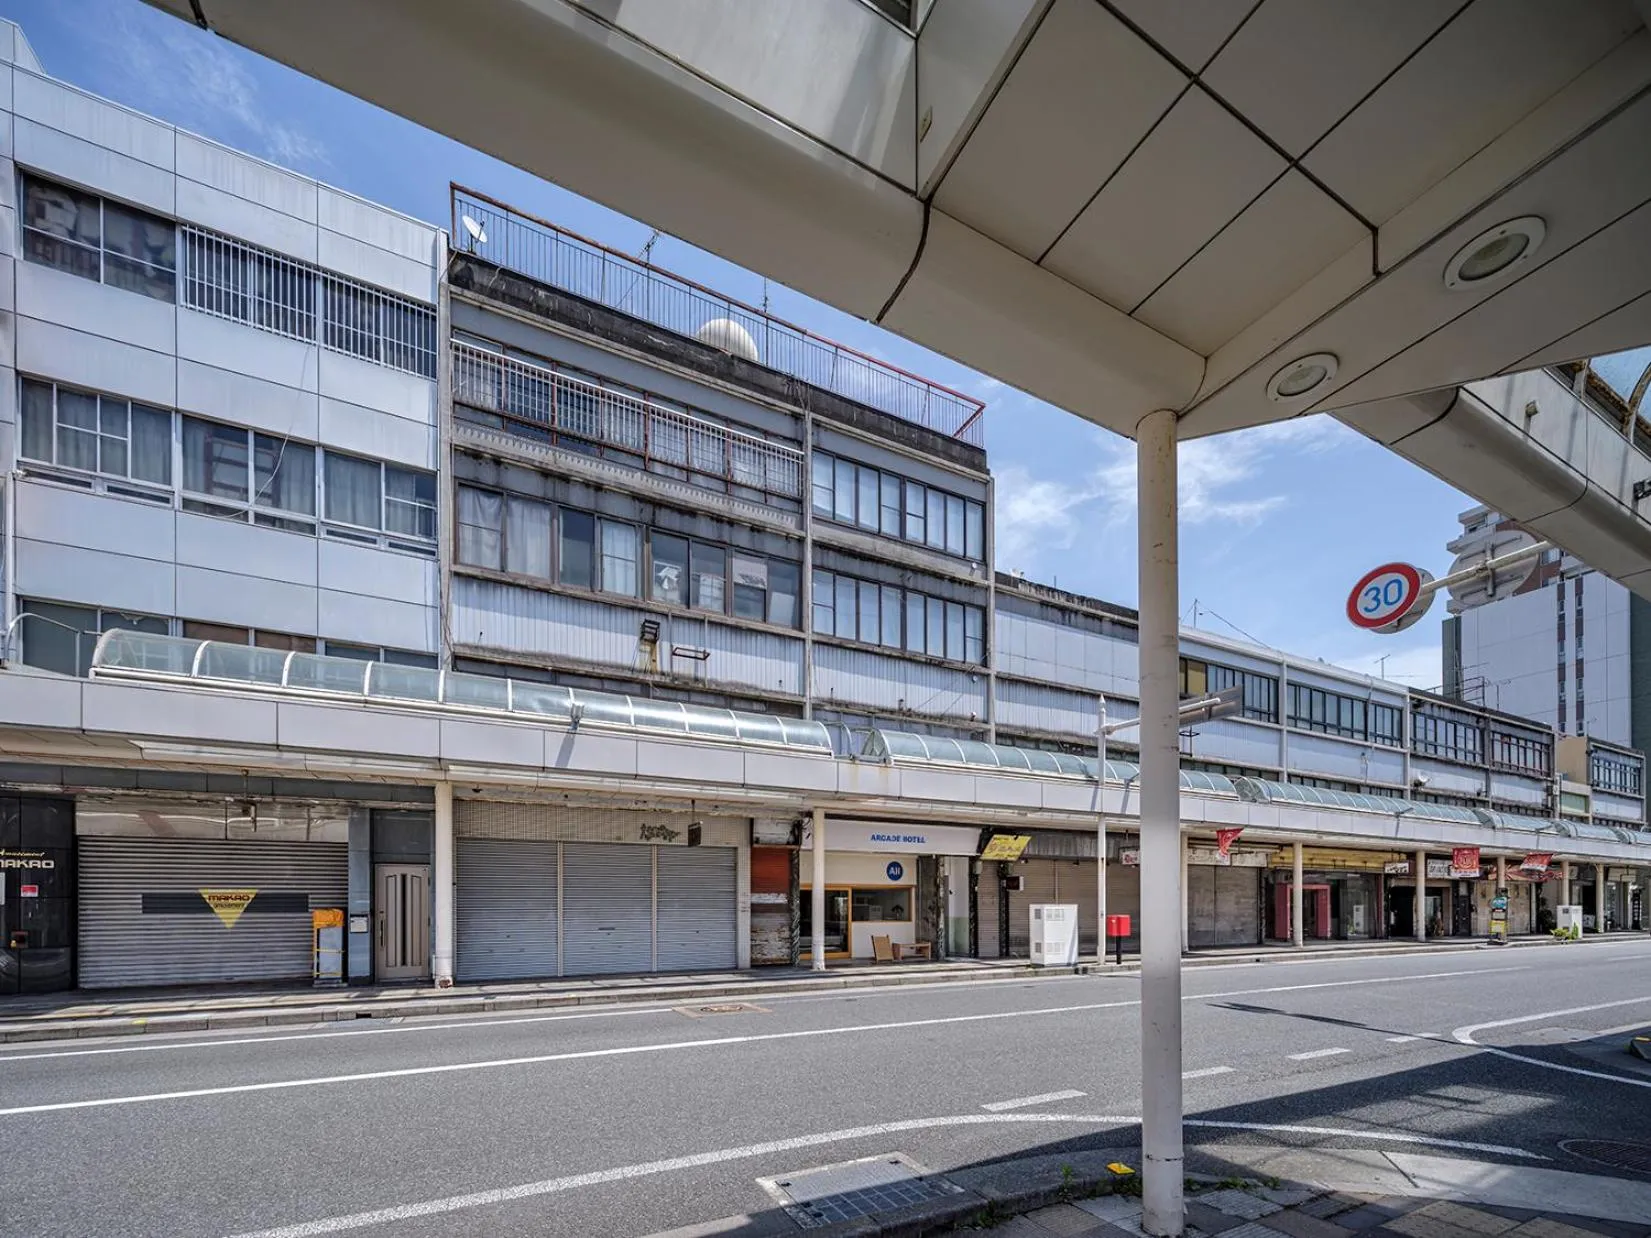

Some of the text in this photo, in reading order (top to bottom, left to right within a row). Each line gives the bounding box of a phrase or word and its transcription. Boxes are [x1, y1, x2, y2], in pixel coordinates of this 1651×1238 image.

[1364, 579, 1402, 613] 30
[871, 834, 926, 844] ARCADE HOTEL
